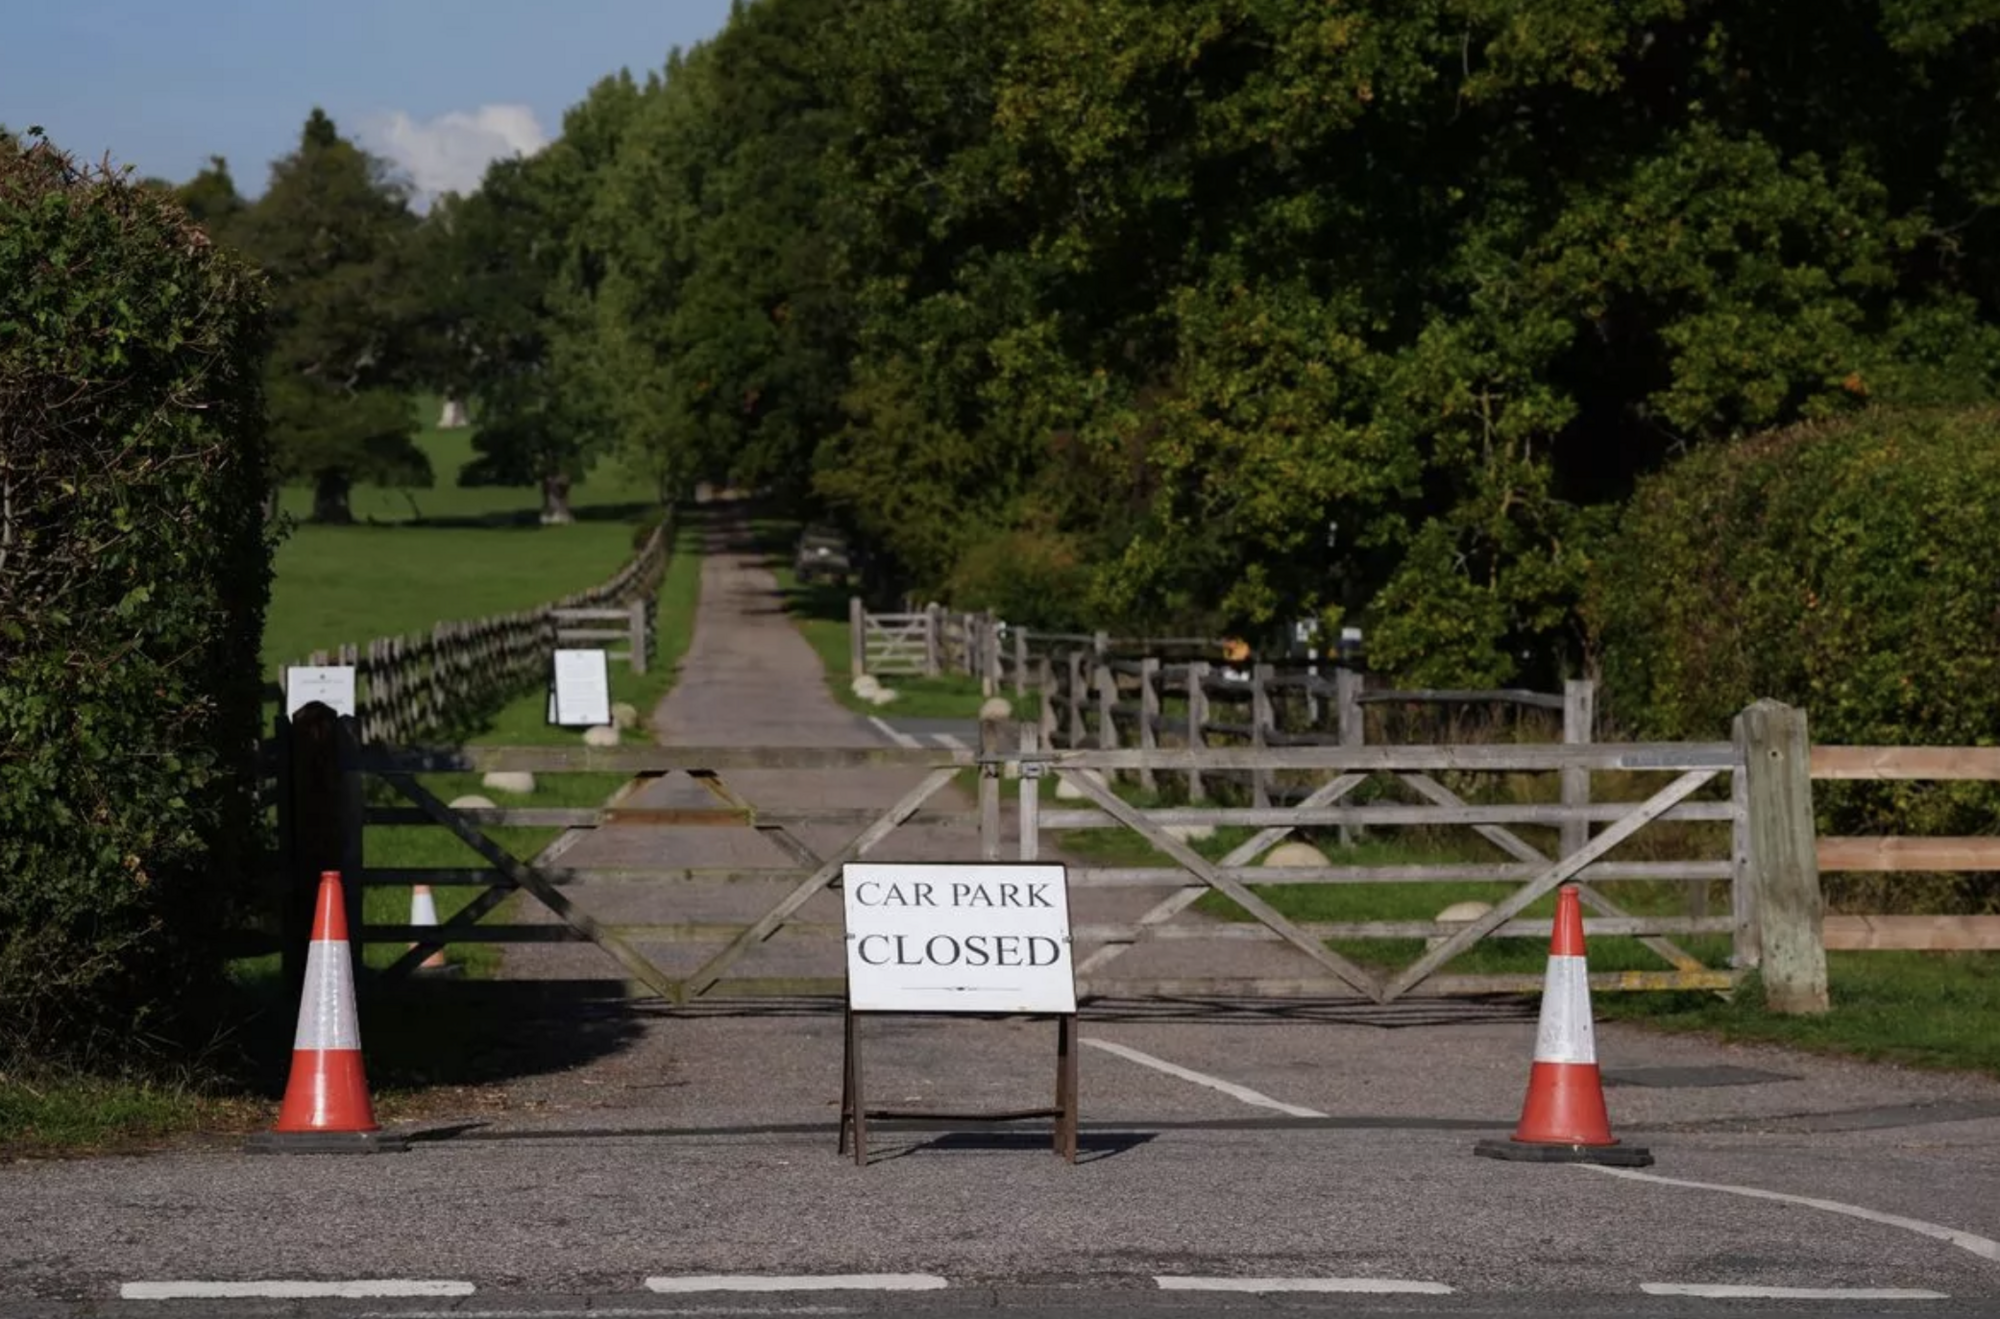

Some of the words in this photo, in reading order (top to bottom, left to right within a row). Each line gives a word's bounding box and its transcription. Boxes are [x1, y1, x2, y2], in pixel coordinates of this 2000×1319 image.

[855, 881, 939, 907] CAR
[951, 882, 1055, 908] PARK
[857, 934, 1061, 967] CLOSED
